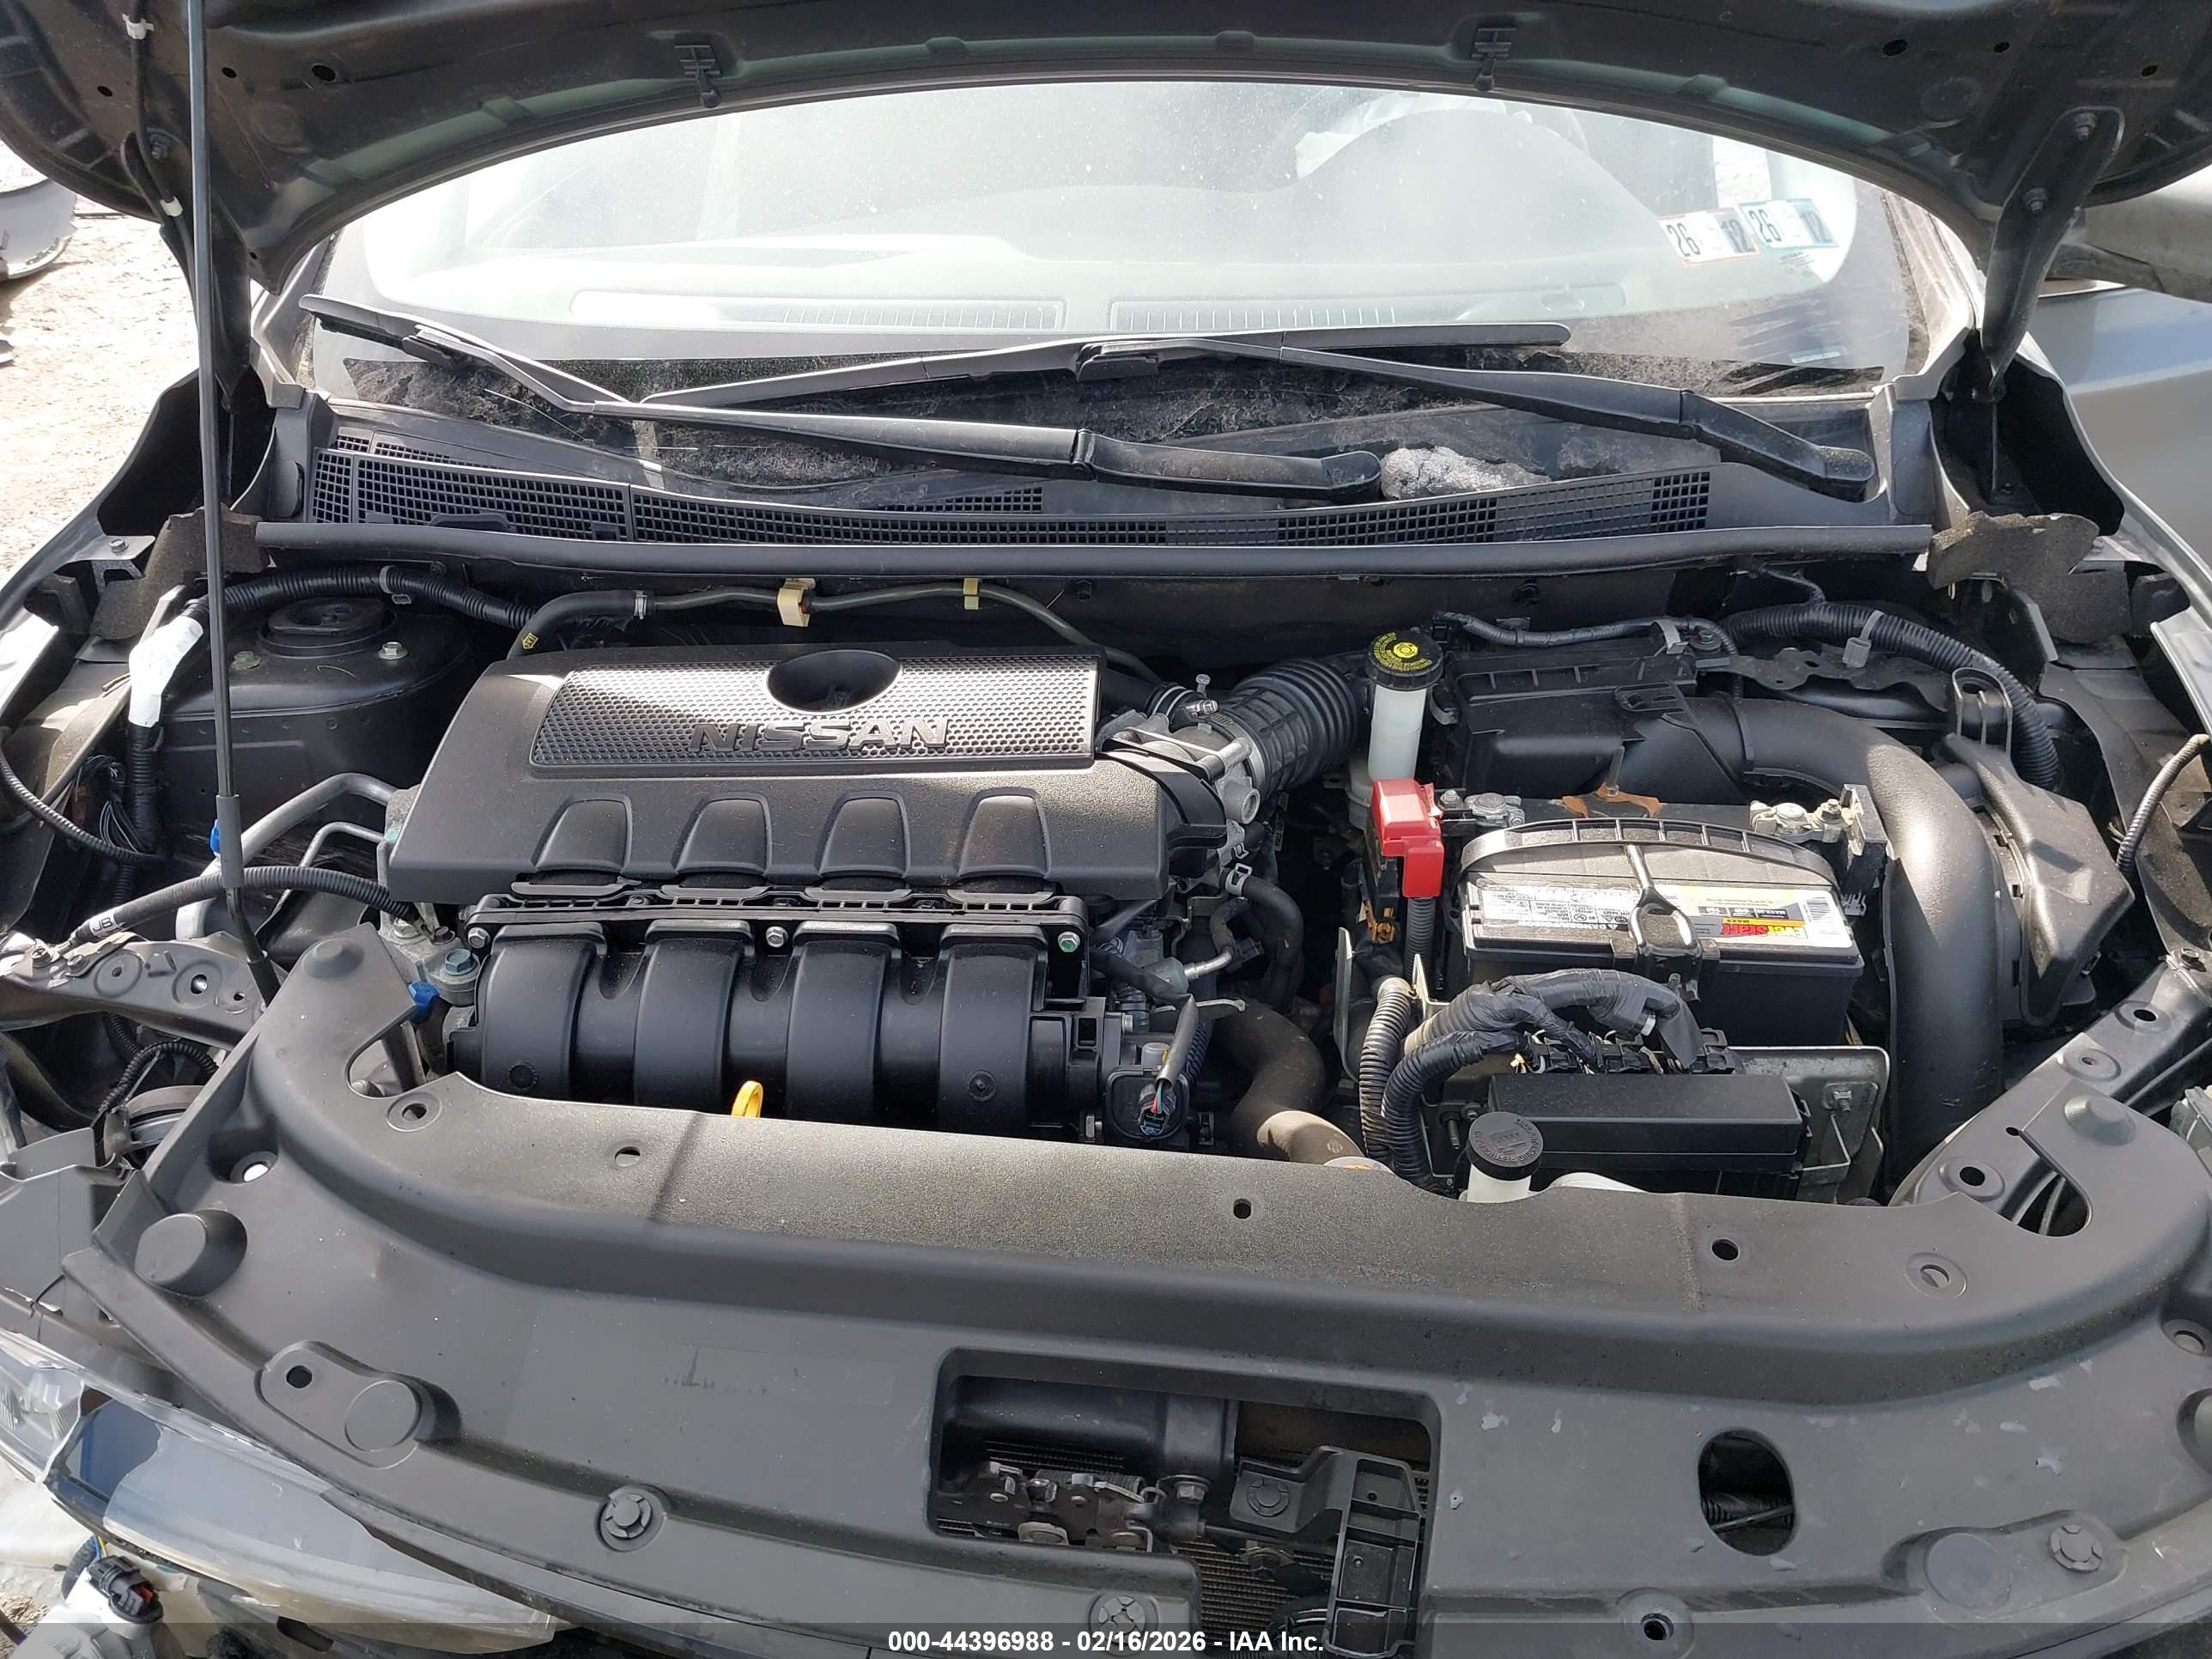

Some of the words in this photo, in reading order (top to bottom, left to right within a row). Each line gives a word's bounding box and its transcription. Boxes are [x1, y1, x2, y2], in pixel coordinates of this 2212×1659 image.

[1666, 222, 1701, 257] 26
[1721, 219, 1757, 254] 12
[1748, 209, 1782, 243] 26
[688, 719, 949, 752] NISSAN
